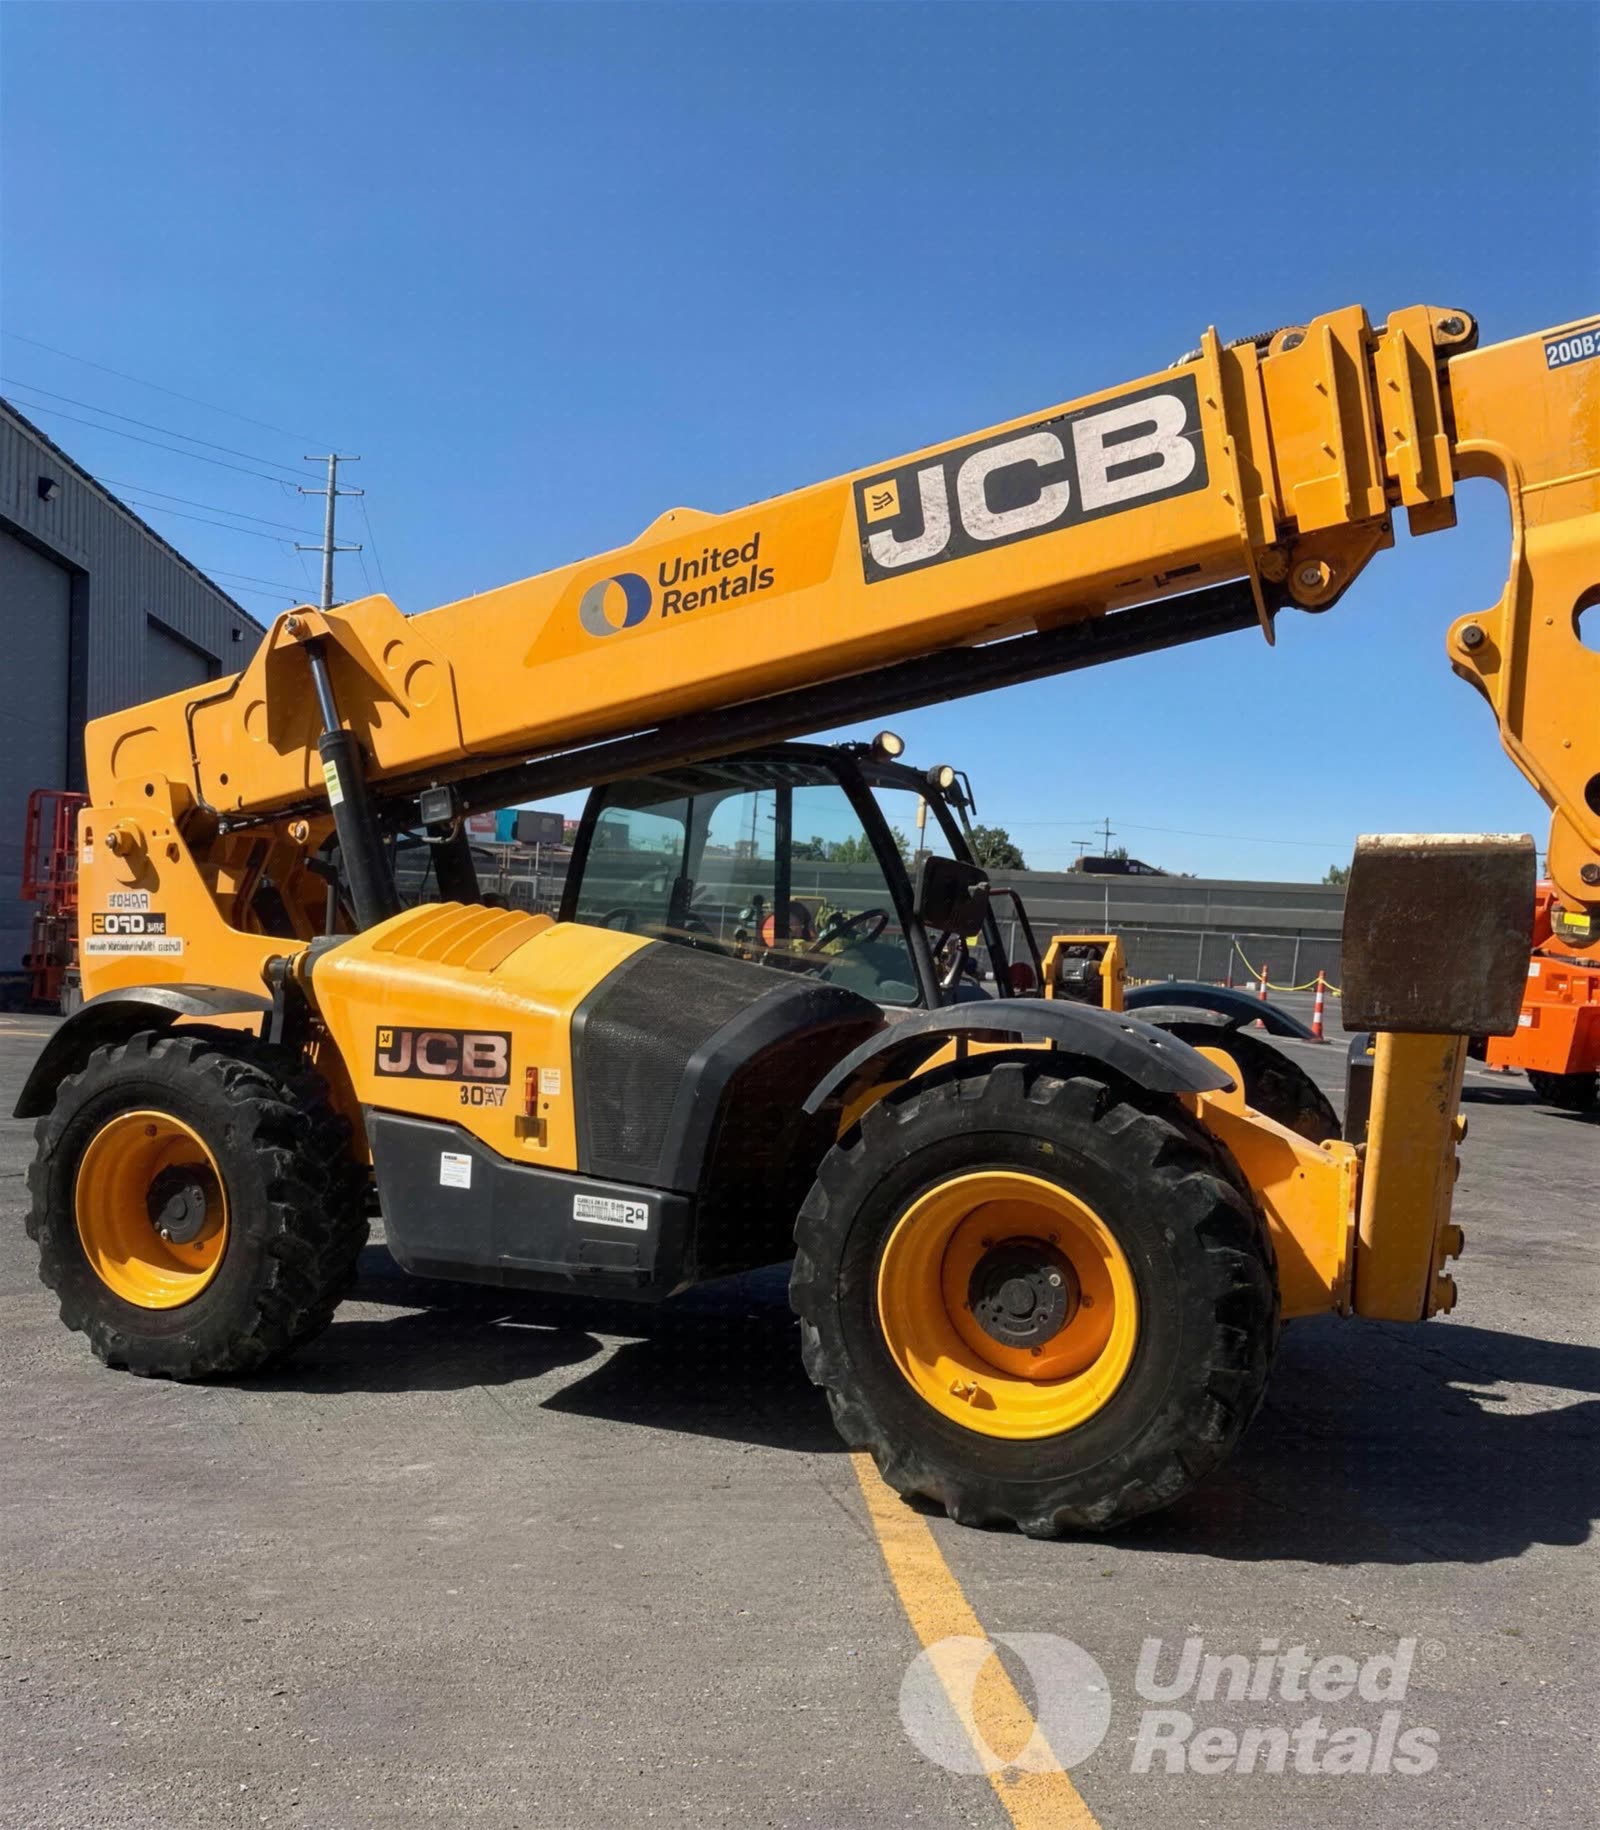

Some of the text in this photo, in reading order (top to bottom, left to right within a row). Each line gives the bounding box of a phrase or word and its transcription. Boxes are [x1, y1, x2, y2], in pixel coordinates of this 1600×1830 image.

[868, 394, 1196, 569] JCB
[658, 532, 761, 588] United
[661, 564, 775, 618] Rentals
[378, 1031, 508, 1079] JCB
